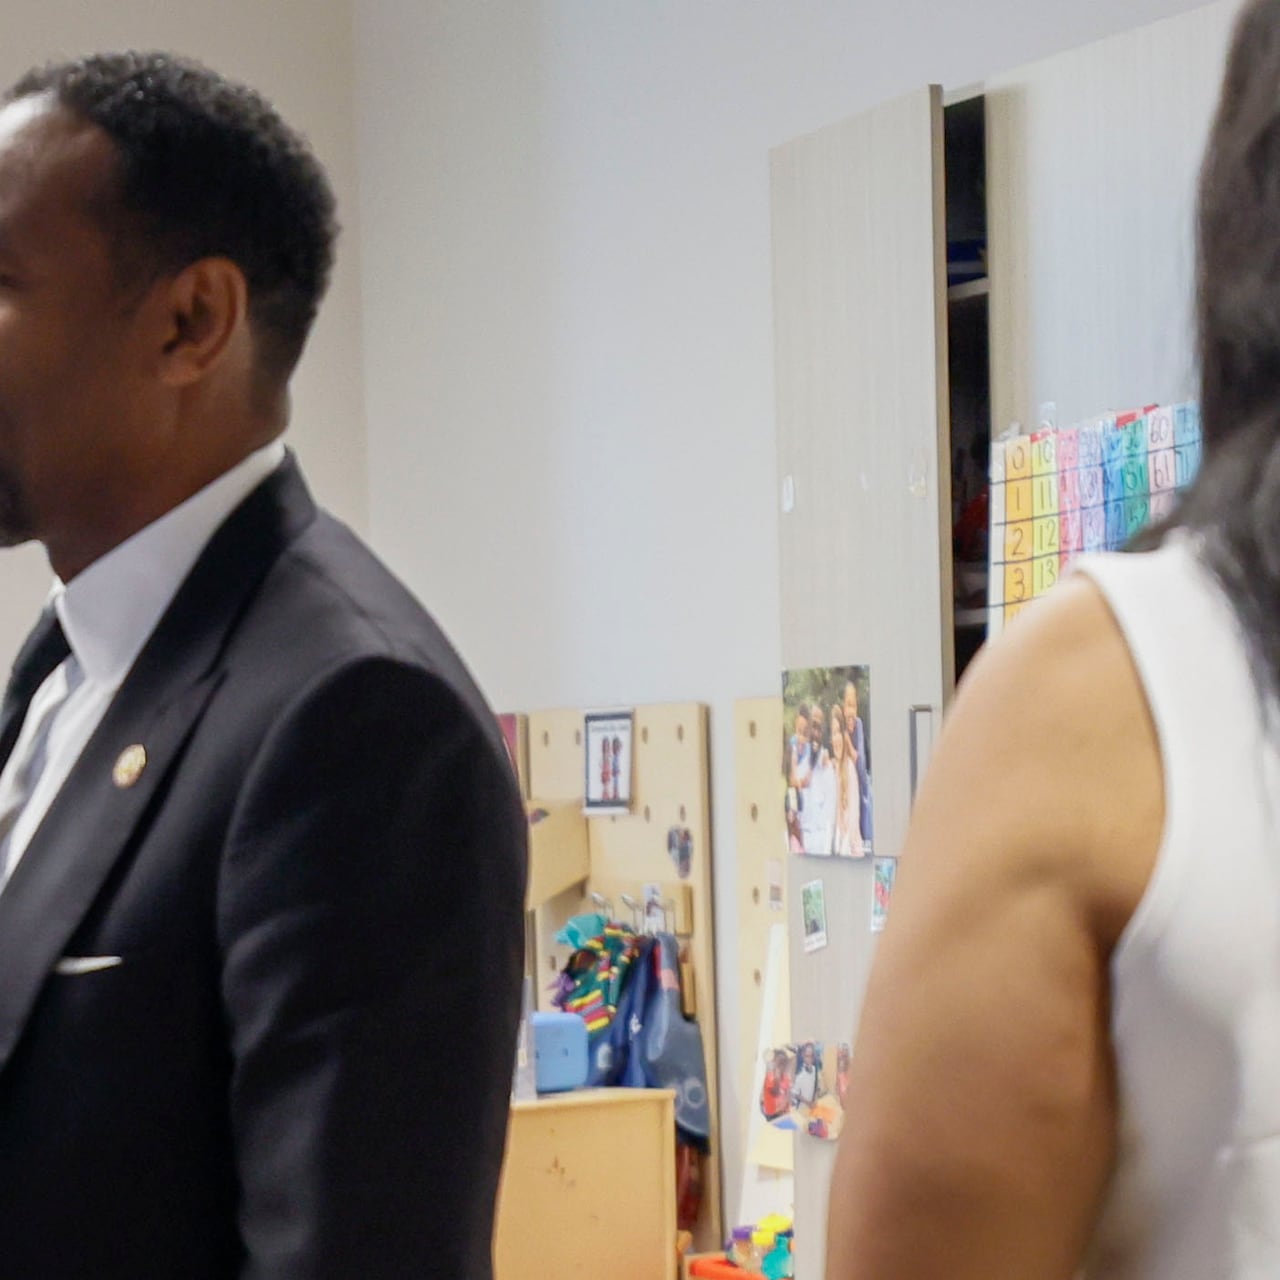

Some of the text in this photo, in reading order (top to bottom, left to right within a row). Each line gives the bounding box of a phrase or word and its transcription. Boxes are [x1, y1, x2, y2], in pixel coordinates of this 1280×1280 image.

[1011, 445, 1025, 471] 0
[1037, 439, 1053, 464] 10
[1150, 414, 1169, 444] 60
[1015, 485, 1022, 511] 1
[1040, 480, 1053, 514] 11
[1152, 452, 1170, 489] 61
[1011, 526, 1025, 556] 2
[1038, 518, 1057, 549] 12
[1012, 557, 1057, 602] 3 13
